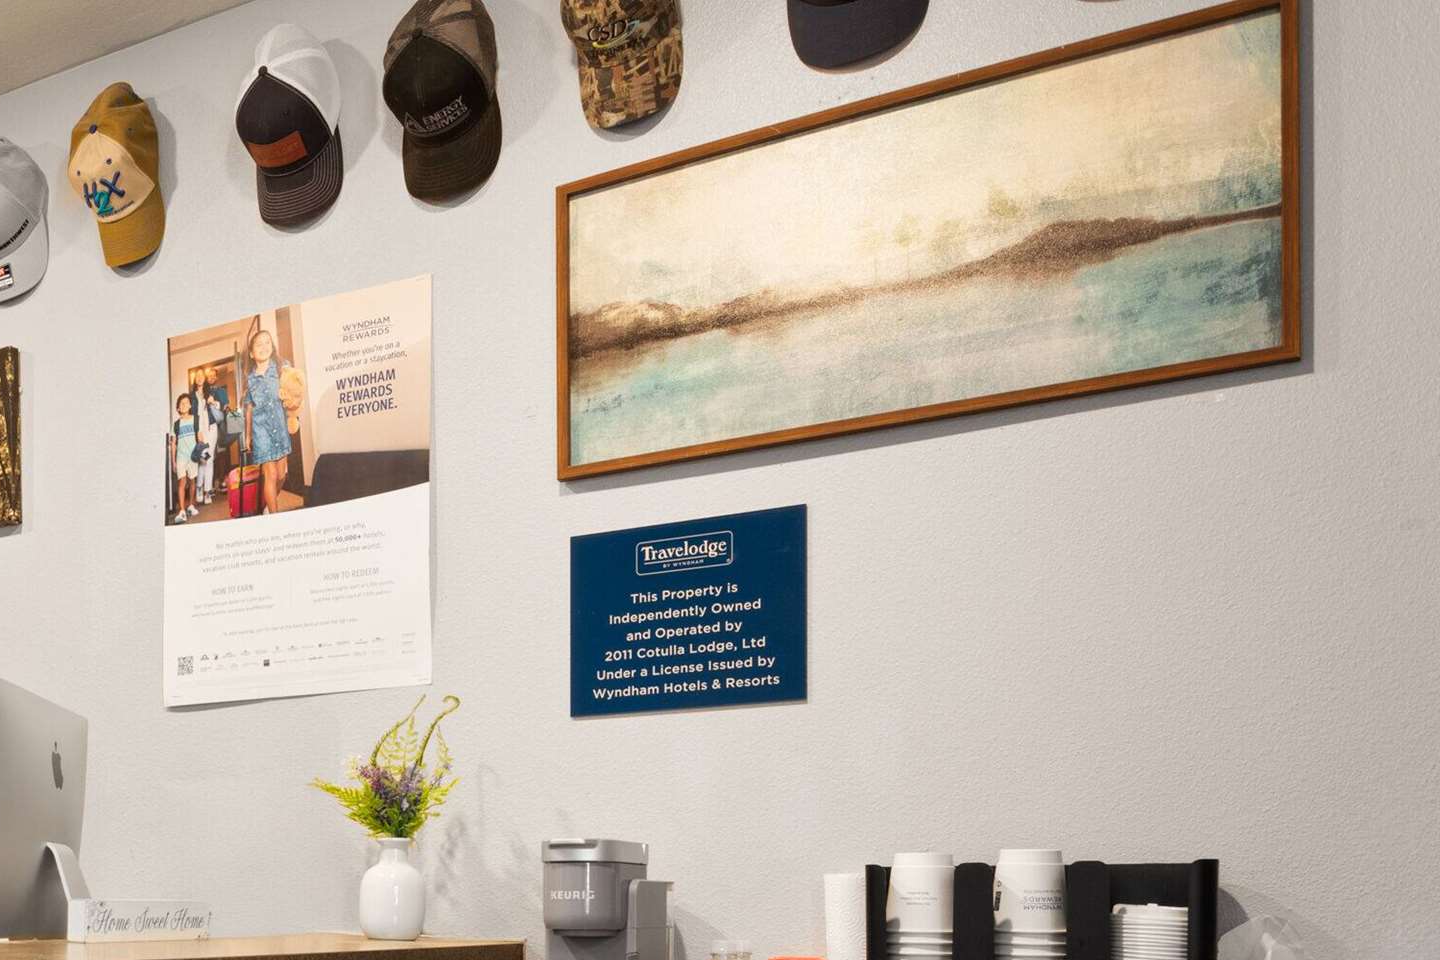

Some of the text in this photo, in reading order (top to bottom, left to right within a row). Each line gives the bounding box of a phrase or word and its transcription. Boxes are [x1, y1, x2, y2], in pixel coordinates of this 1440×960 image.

[422, 95, 462, 125] ENERGY
[343, 316, 390, 332] WYNDHAM
[343, 327, 390, 342] REWARDS
[325, 361, 353, 372] vacation
[370, 350, 407, 363] staycation,
[332, 348, 360, 360] Whether
[362, 344, 382, 356] you're
[385, 342, 394, 350] on
[336, 368, 396, 390] WYNDHAM
[340, 384, 392, 404] REWARDS
[337, 398, 397, 418] EVERYONE.
[641, 540, 727, 561] Travelodge
[673, 559, 704, 567] WYNDHAM
[324, 572, 340, 582] HOW
[342, 571, 350, 579] TO
[631, 583, 738, 604] This Property is
[610, 598, 761, 625] Independently Owned
[626, 621, 742, 641] and Operated by
[605, 637, 766, 662] 2011 Cotulla Lodge, Ltd
[597, 669, 636, 680] Under
[652, 663, 703, 676] License
[708, 657, 752, 671] Issued
[758, 656, 775, 668] by
[593, 675, 780, 700] Wyndham Hotels & Resorts
[550, 890, 596, 900] KEURIG
[93, 906, 205, 934] Home Sweet Home
